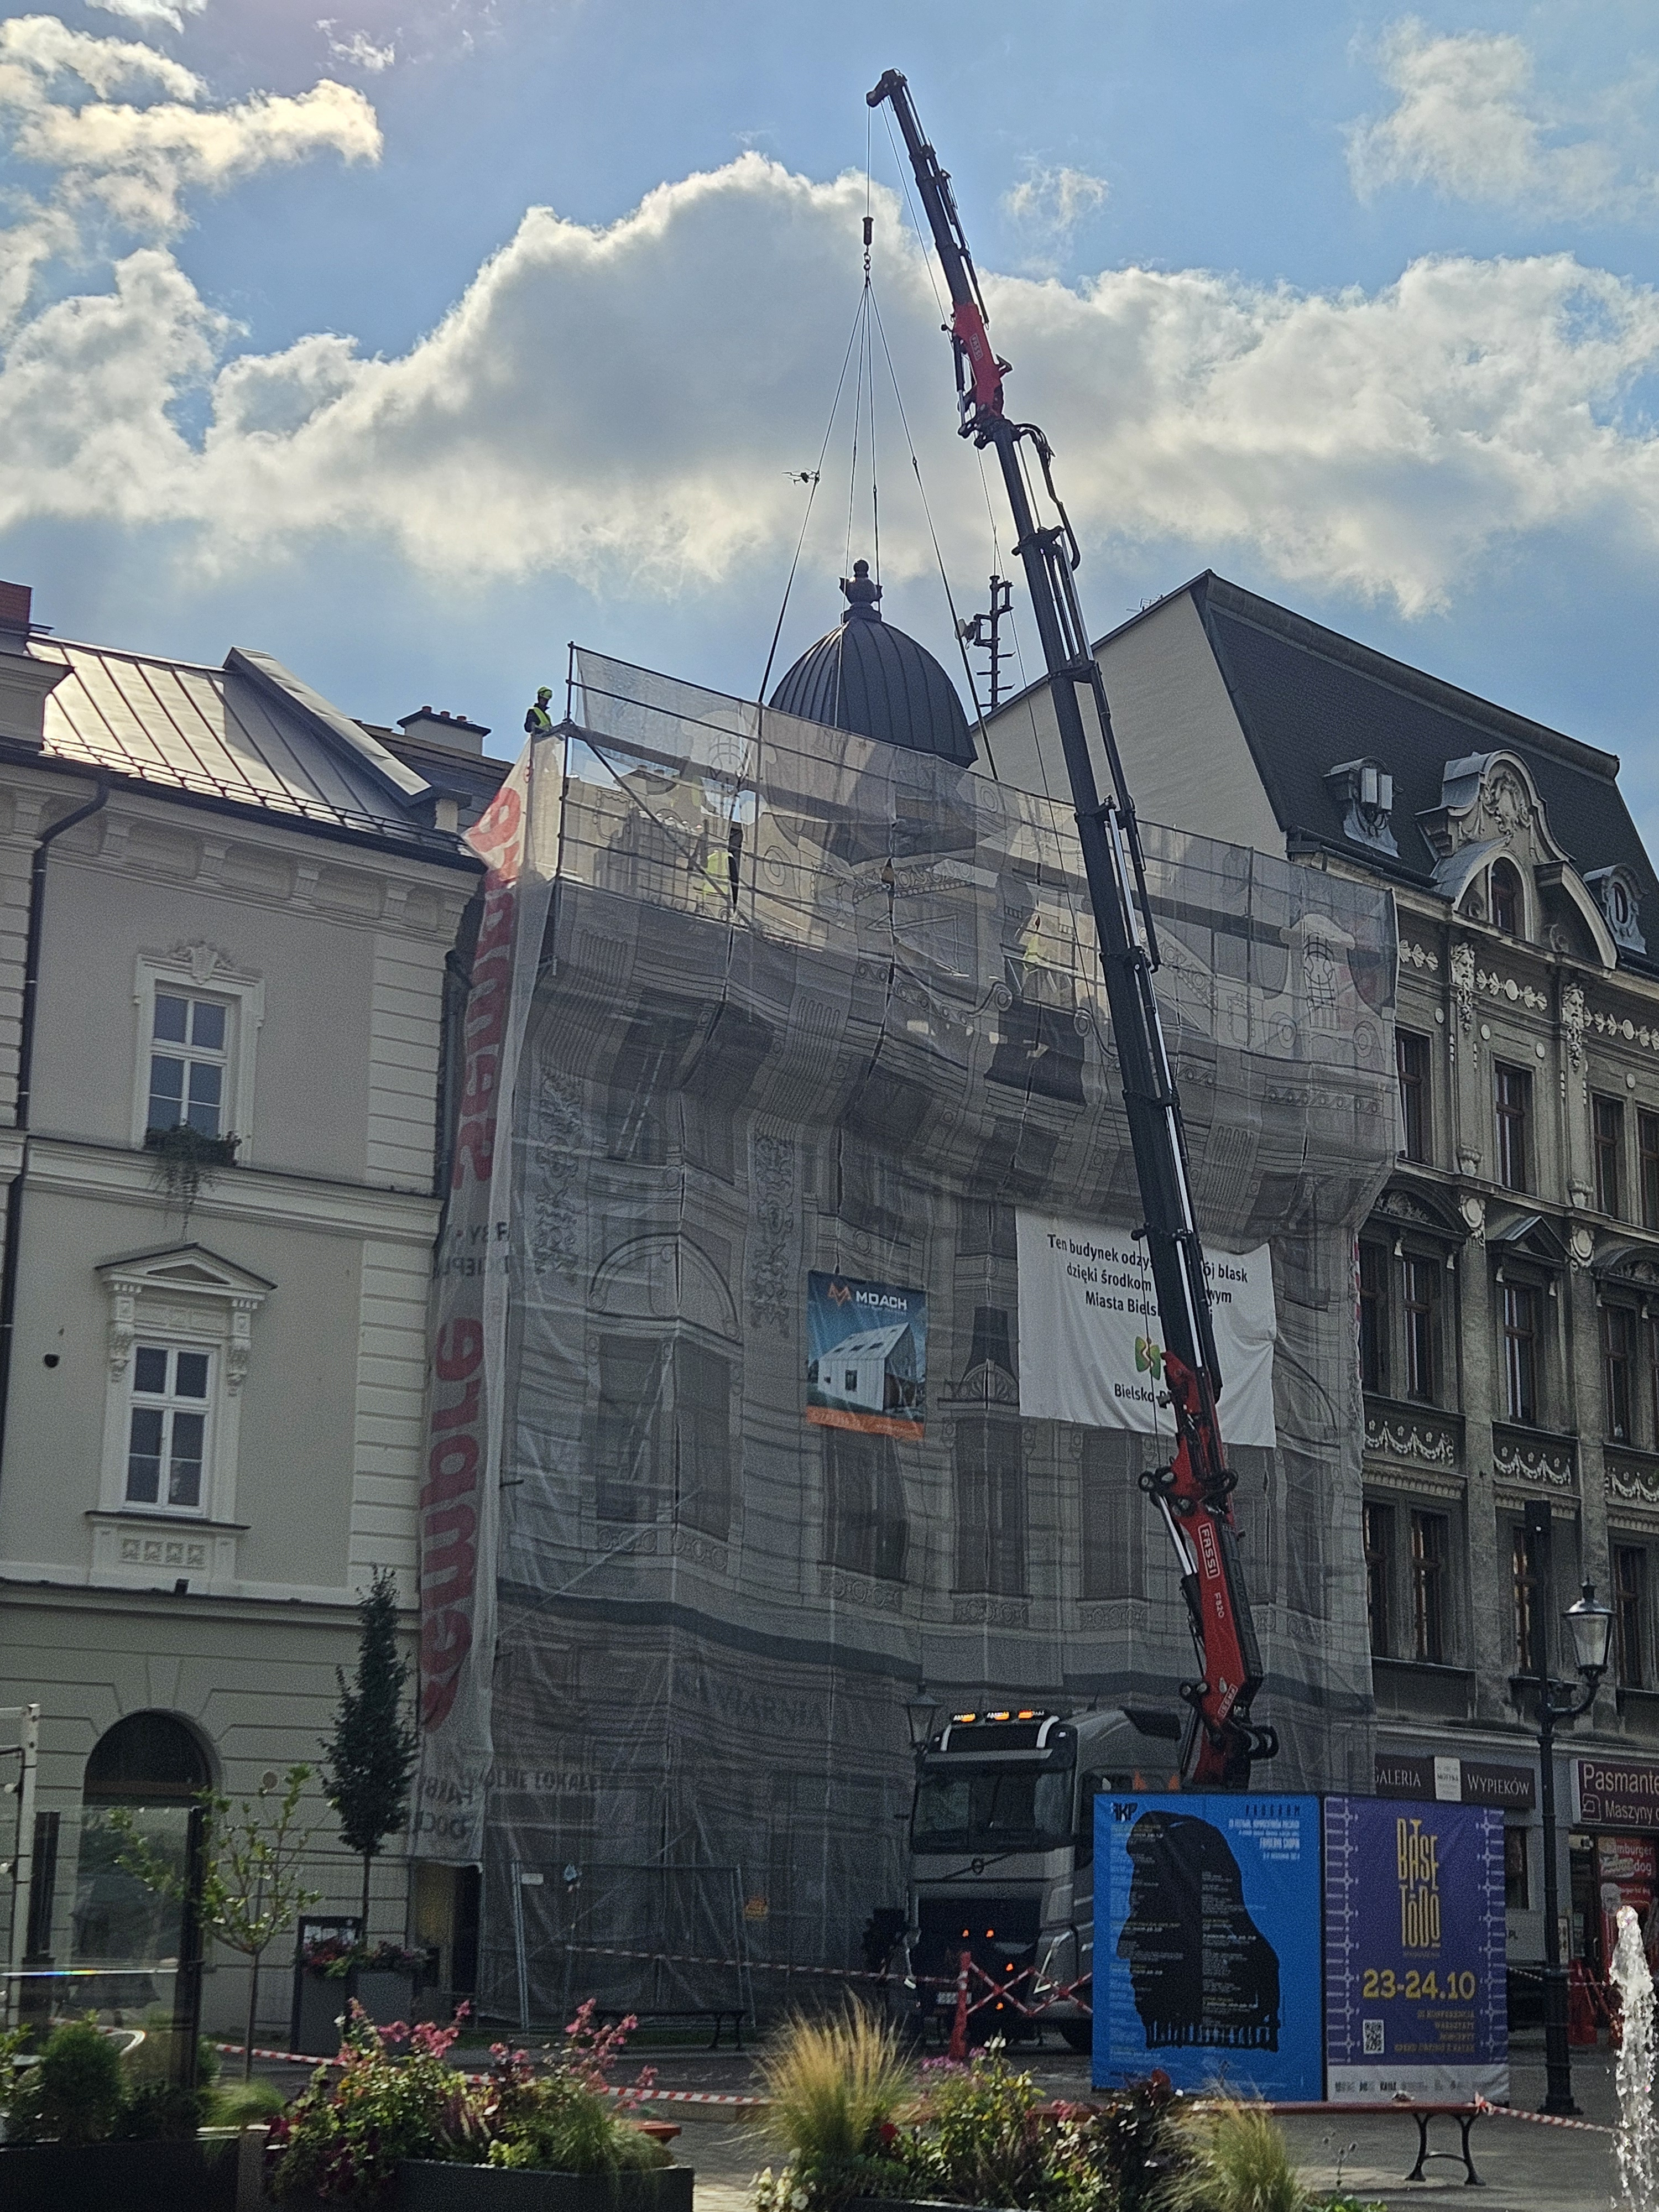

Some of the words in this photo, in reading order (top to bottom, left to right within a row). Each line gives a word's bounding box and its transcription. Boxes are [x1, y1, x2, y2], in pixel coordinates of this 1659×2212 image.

[1047, 1234, 1067, 1251] Ten
[1070, 1239, 1119, 1262] budynek
[1121, 1251, 1152, 1271] odzy
[1218, 1263, 1248, 1283] blask
[1067, 1262, 1097, 1284] dzięki
[1101, 1269, 1151, 1291] środkom
[856, 1290, 907, 1311] MOACH
[1086, 1290, 1124, 1311] Miasta
[1128, 1298, 1160, 1317] Biels
[1201, 1528, 1217, 1574] FASSI
[1467, 1773, 1530, 1796] WYPIEKÓW
[1583, 1763, 1659, 1795] Pasmante
[1605, 1799, 1653, 1825] Maszyny
[1634, 1859, 1652, 1876] dog
[1363, 1968, 1475, 2000] 23-24.10
